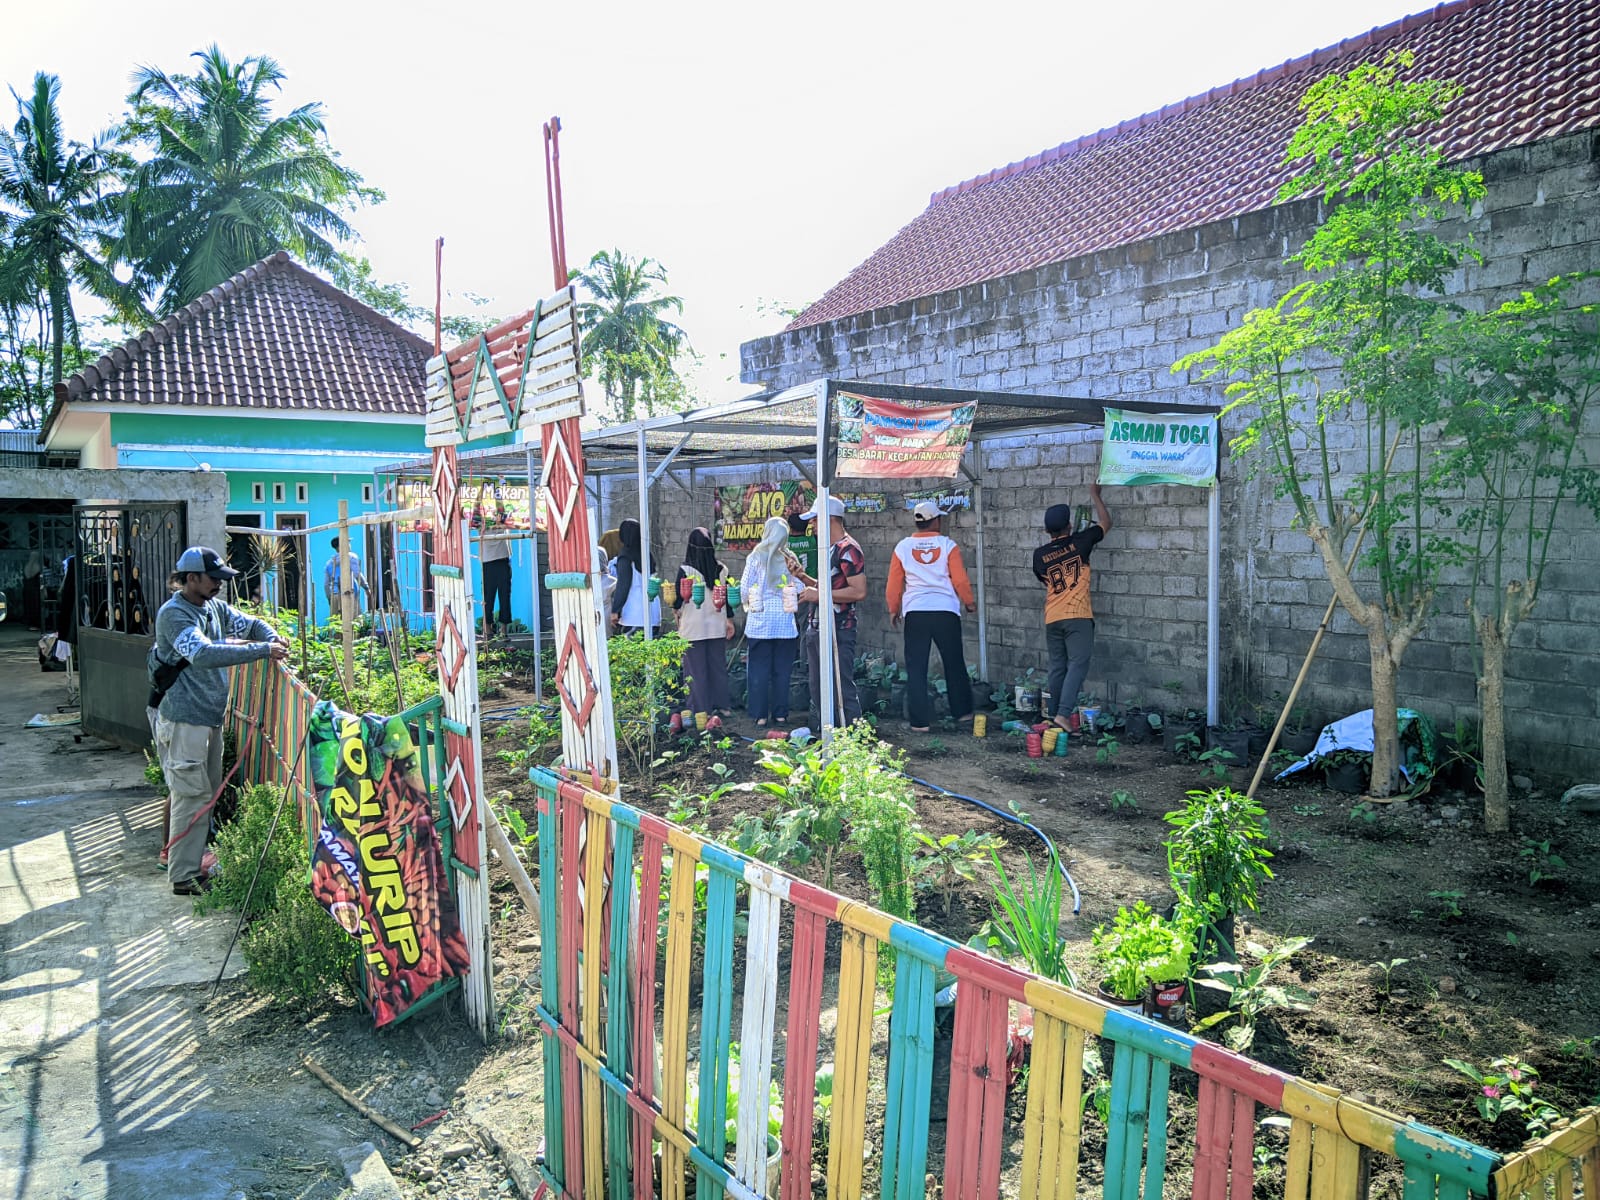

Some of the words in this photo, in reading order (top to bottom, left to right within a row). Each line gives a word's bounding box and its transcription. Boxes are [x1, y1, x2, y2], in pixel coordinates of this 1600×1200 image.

[1109, 421, 1166, 444] ASMAN
[1169, 424, 1210, 445] TOGA
[837, 447, 858, 459] DESA
[859, 449, 886, 460] BARAT
[482, 483, 526, 499] Makan
[749, 492, 784, 519] AYO
[723, 524, 763, 539] NANDUR
[360, 833, 420, 964] URIP
